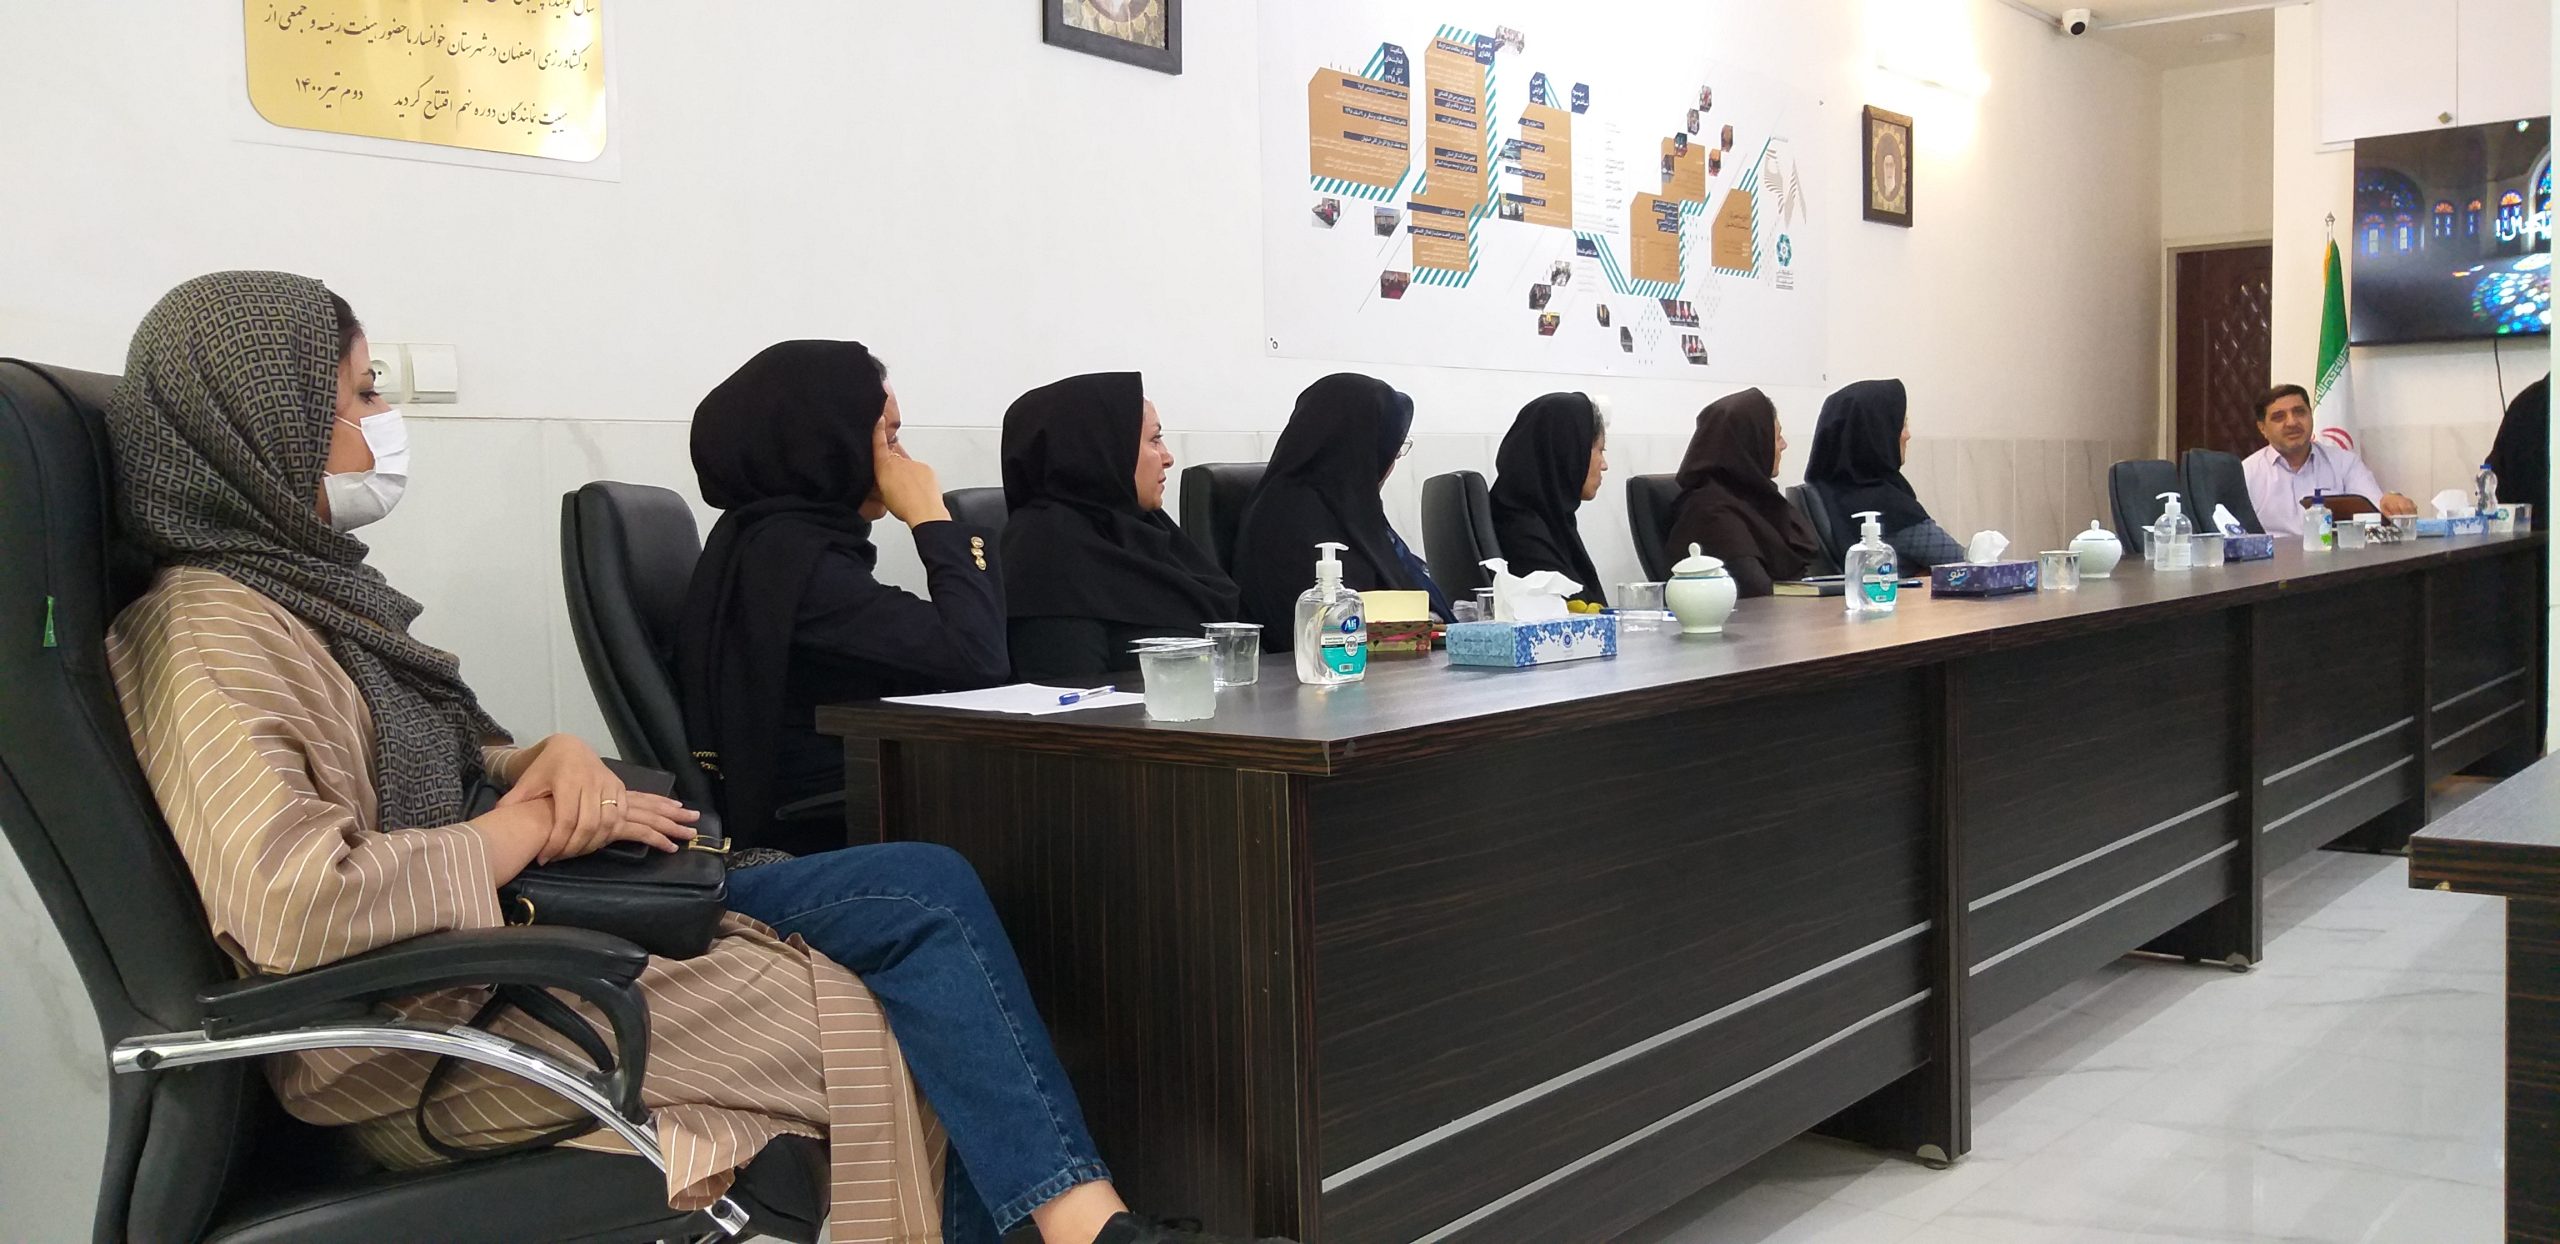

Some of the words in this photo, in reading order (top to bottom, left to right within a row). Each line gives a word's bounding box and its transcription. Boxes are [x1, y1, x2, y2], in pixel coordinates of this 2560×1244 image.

[264, 3, 277, 23] از
[278, 4, 307, 34] جمعی
[309, 18, 316, 29] و
[412, 23, 446, 48] خوانسار
[446, 32, 488, 58] شهرستان
[488, 46, 497, 56] در
[498, 41, 536, 64] اصفهان
[538, 42, 593, 70] کشاورزی
[295, 77, 321, 94] ۱۴۰۰
[318, 71, 341, 108] تیر
[340, 88, 363, 106] دوم
[423, 89, 453, 120] افتتاح
[474, 106, 496, 117] دوره
